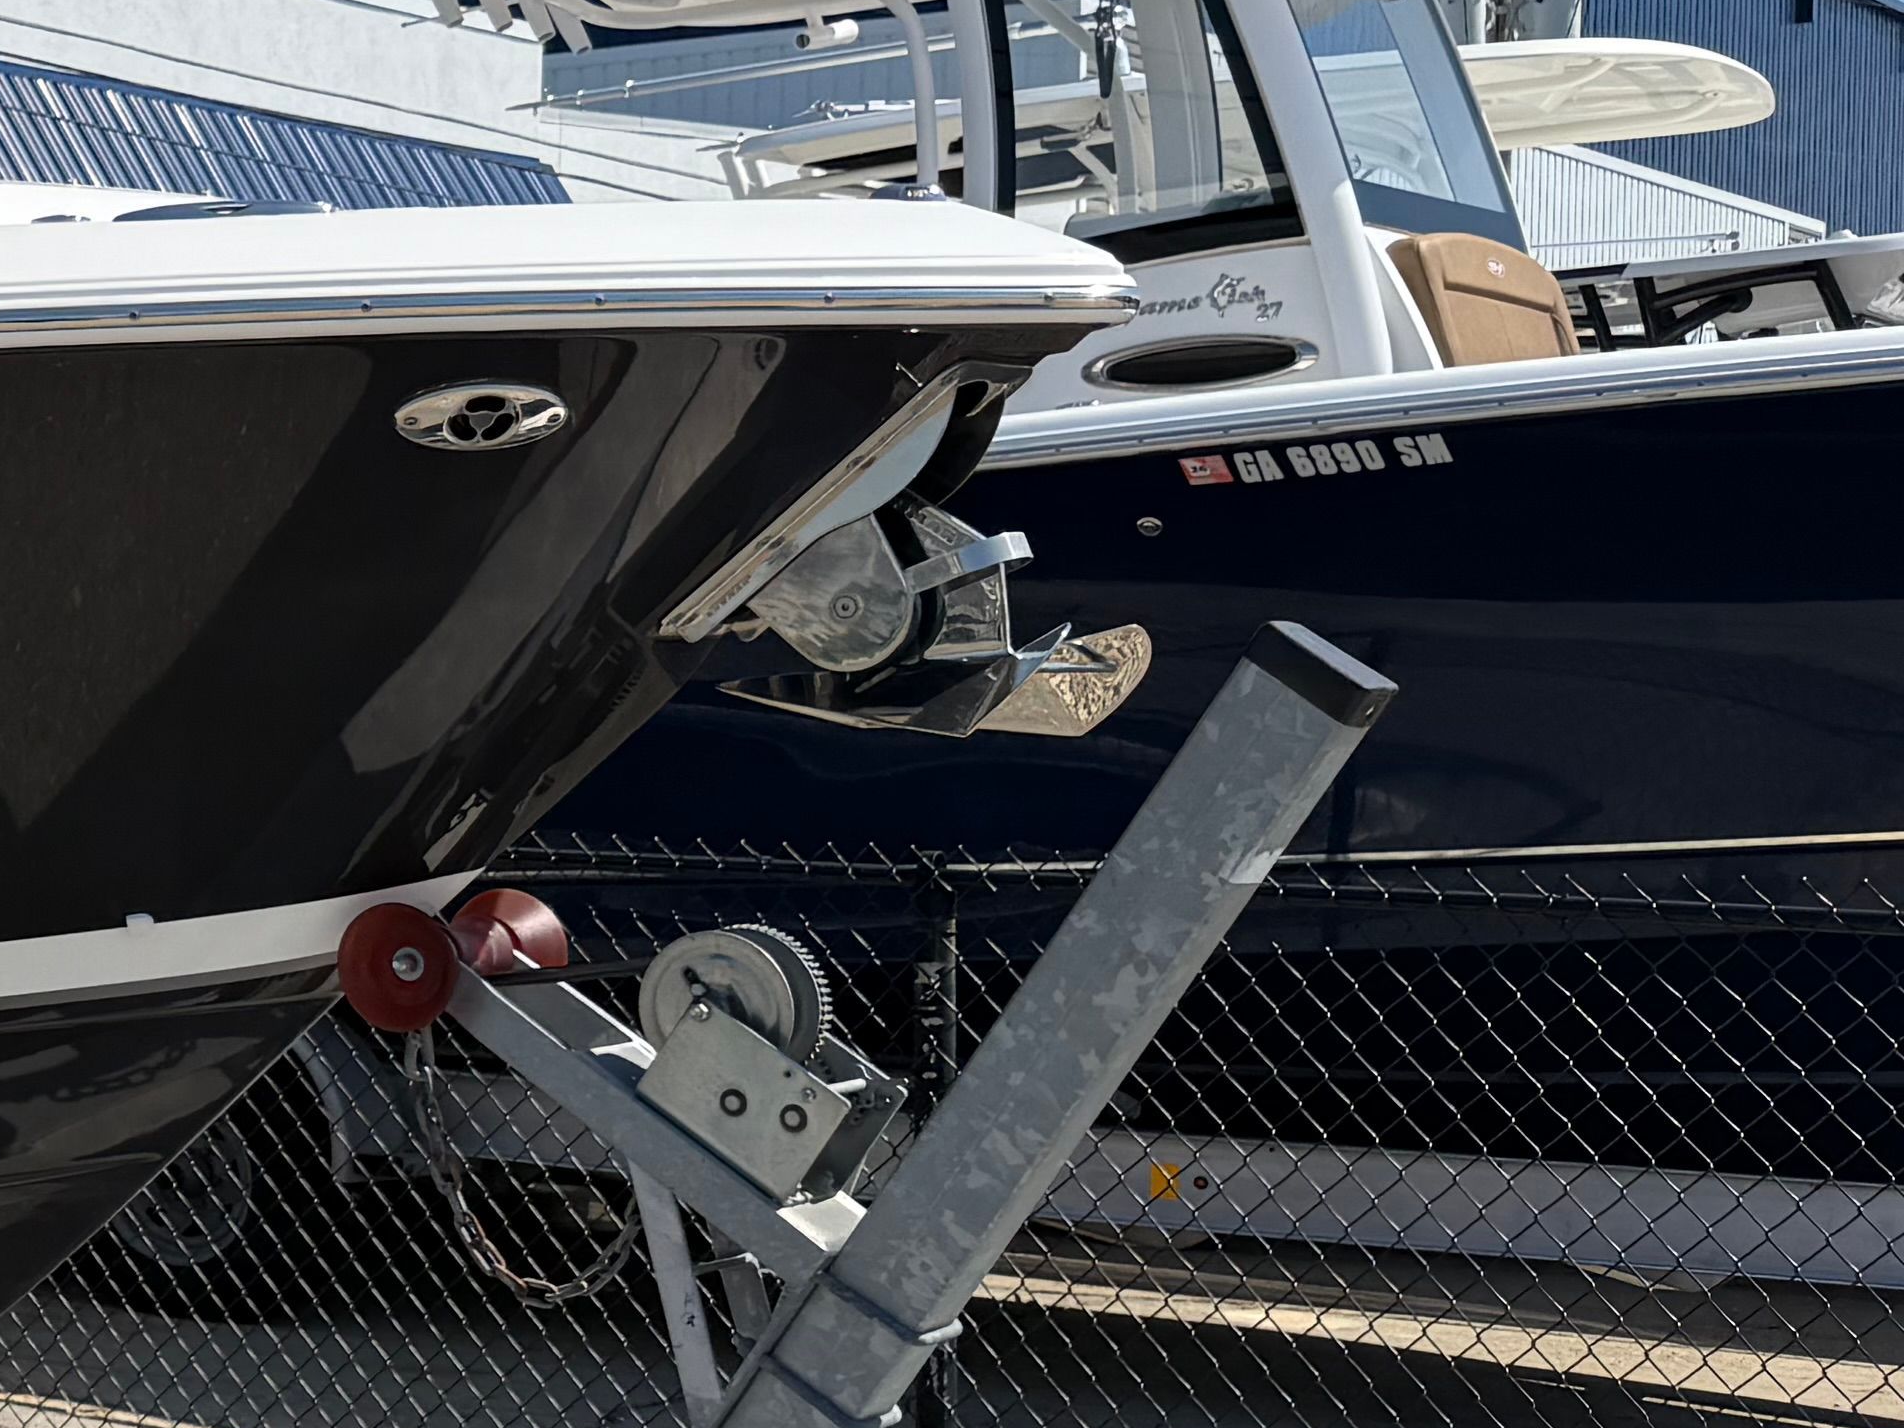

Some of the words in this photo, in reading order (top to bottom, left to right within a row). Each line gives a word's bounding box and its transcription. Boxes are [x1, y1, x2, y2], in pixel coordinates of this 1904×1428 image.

[1255, 300, 1283, 322] 27
[1233, 450, 1284, 483] GA
[1286, 439, 1385, 477] 6890
[1393, 433, 1454, 467] SM
